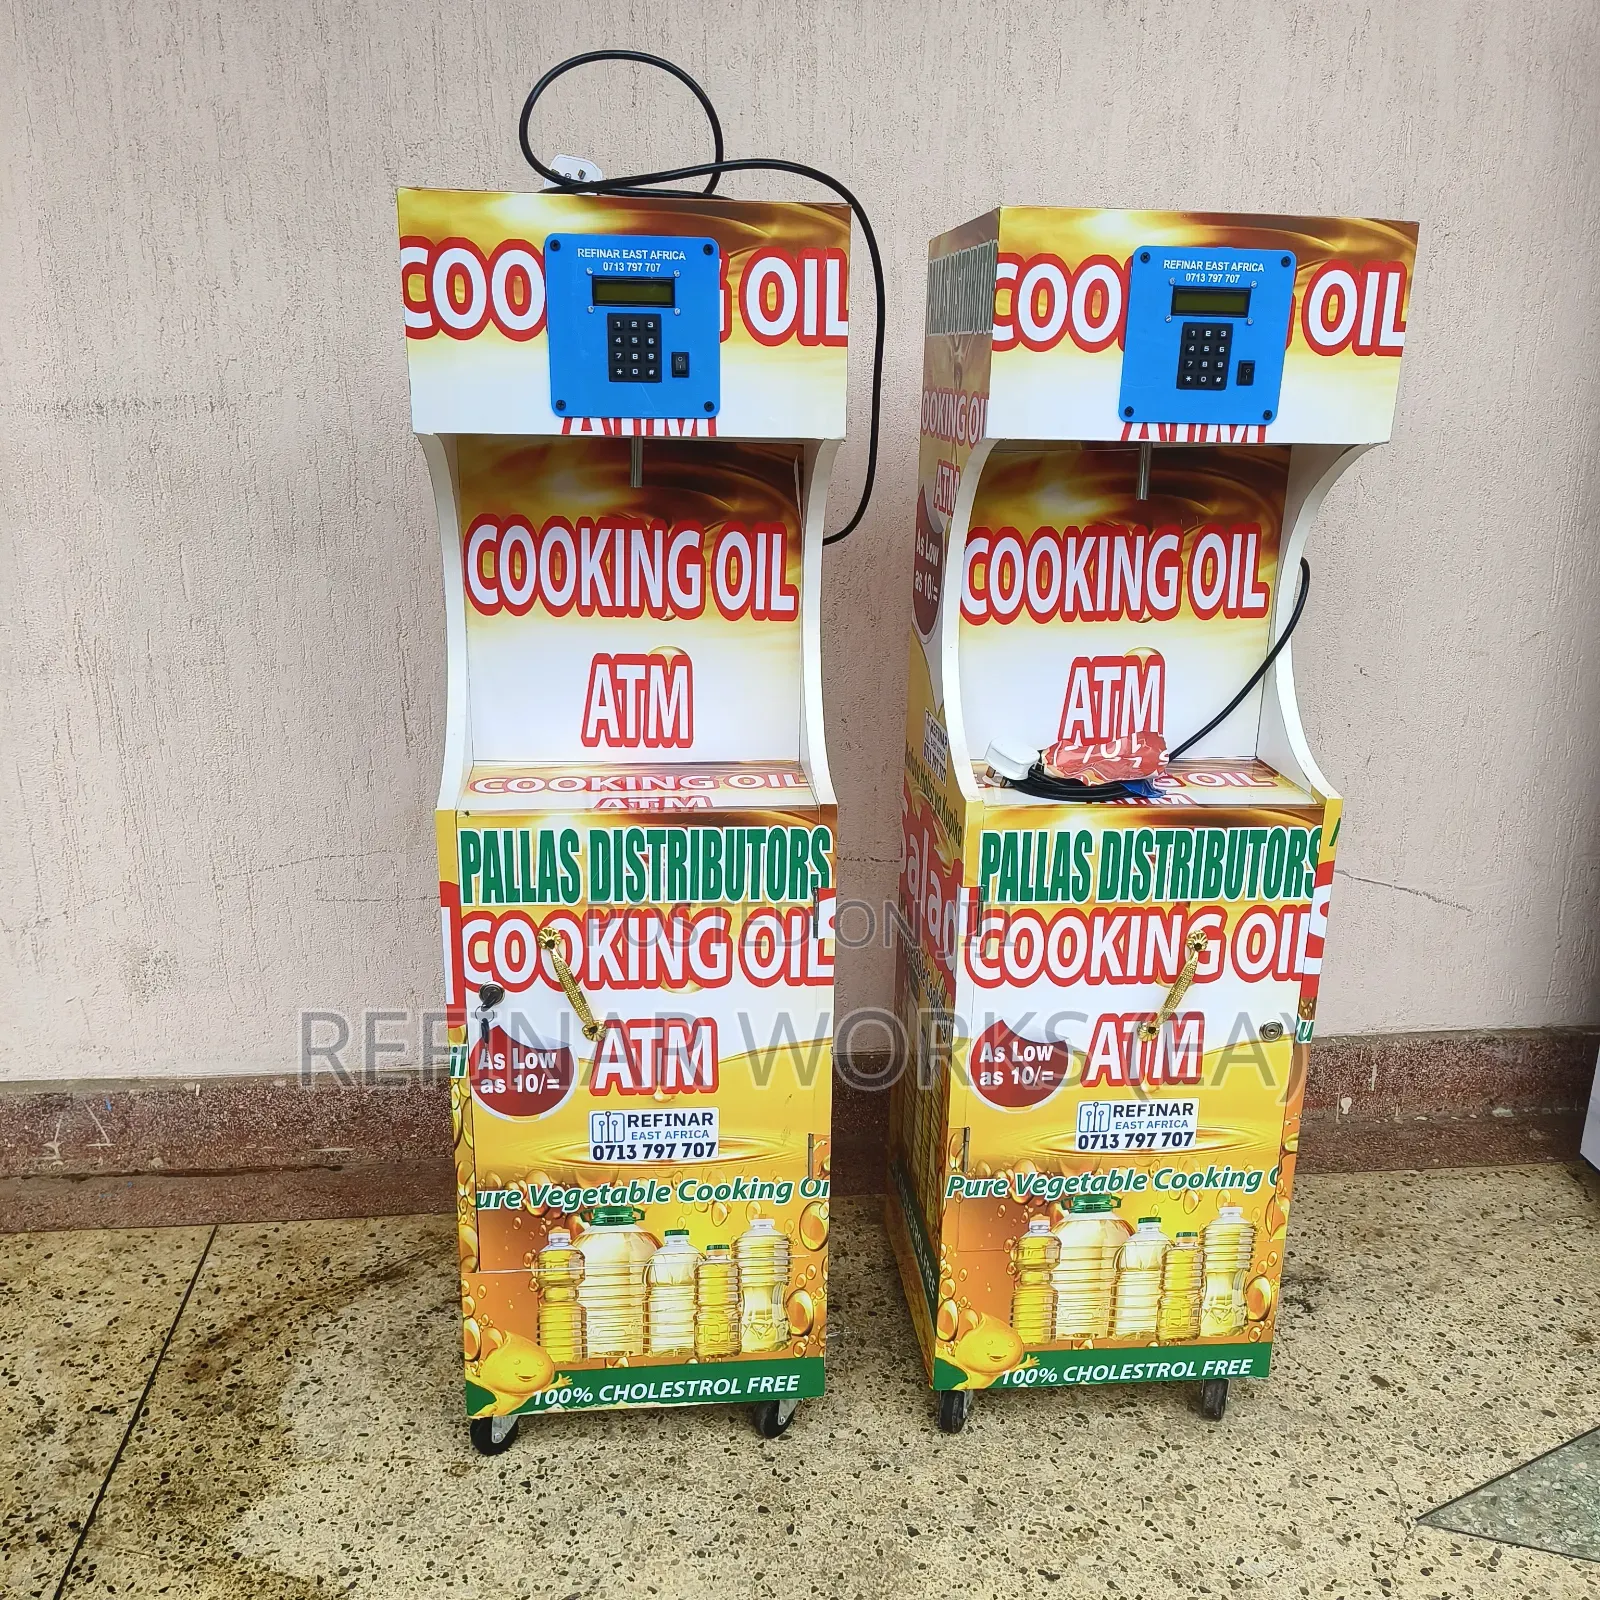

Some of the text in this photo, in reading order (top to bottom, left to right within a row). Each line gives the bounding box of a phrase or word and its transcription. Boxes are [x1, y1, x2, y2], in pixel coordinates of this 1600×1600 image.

[577, 248, 686, 261] REFINAR EAST AFRICA
[603, 262, 661, 273] 0713 797 707
[1163, 260, 1264, 273] REFINAR EAST AFRICA
[1186, 273, 1240, 284] 0713 797 707
[742, 250, 848, 345] OIL
[1305, 263, 1406, 354] OIL
[466, 519, 797, 616] COOKING OIL
[961, 526, 1268, 622] COOKING OIL
[583, 657, 692, 745] ATM
[1060, 659, 1164, 745] ATM
[471, 774, 811, 794] COOKING OIL
[1187, 773, 1277, 788] OIL
[596, 796, 713, 809] ATM
[458, 827, 832, 905] PALLAS DISTRIBUTORS
[981, 829, 1093, 903] PALLAS
[1098, 826, 1322, 903] DISTRIBUTORS
[463, 913, 731, 986] COOKING
[742, 911, 834, 985] OIL
[967, 911, 1224, 986] COOKING
[479, 1048, 557, 1070] As Low
[592, 1021, 716, 1093] ATM
[980, 1042, 1054, 1062] As Low
[1083, 1015, 1203, 1084] ATM
[480, 1074, 560, 1095] as 10/=
[980, 1067, 1054, 1087] as 10/=
[627, 1112, 714, 1128] REFINAR
[1113, 1102, 1194, 1118] REFINAR
[631, 1129, 710, 1141] EAST AFRICA
[1115, 1119, 1189, 1130] EAST AFRICA
[592, 1141, 717, 1161] 0713 797 707
[1078, 1131, 1195, 1150] 0713 797 707
[945, 1174, 1008, 1199] Pure
[1015, 1168, 1146, 1201] Vegetable
[1152, 1165, 1264, 1195] Cooking
[528, 1179, 671, 1213] Vegetable
[676, 1176, 794, 1206] Cooking
[1001, 1358, 1255, 1386] 100% CHOLESTROL FREE
[533, 1373, 801, 1406] 100% CHOLESTROL FREE
